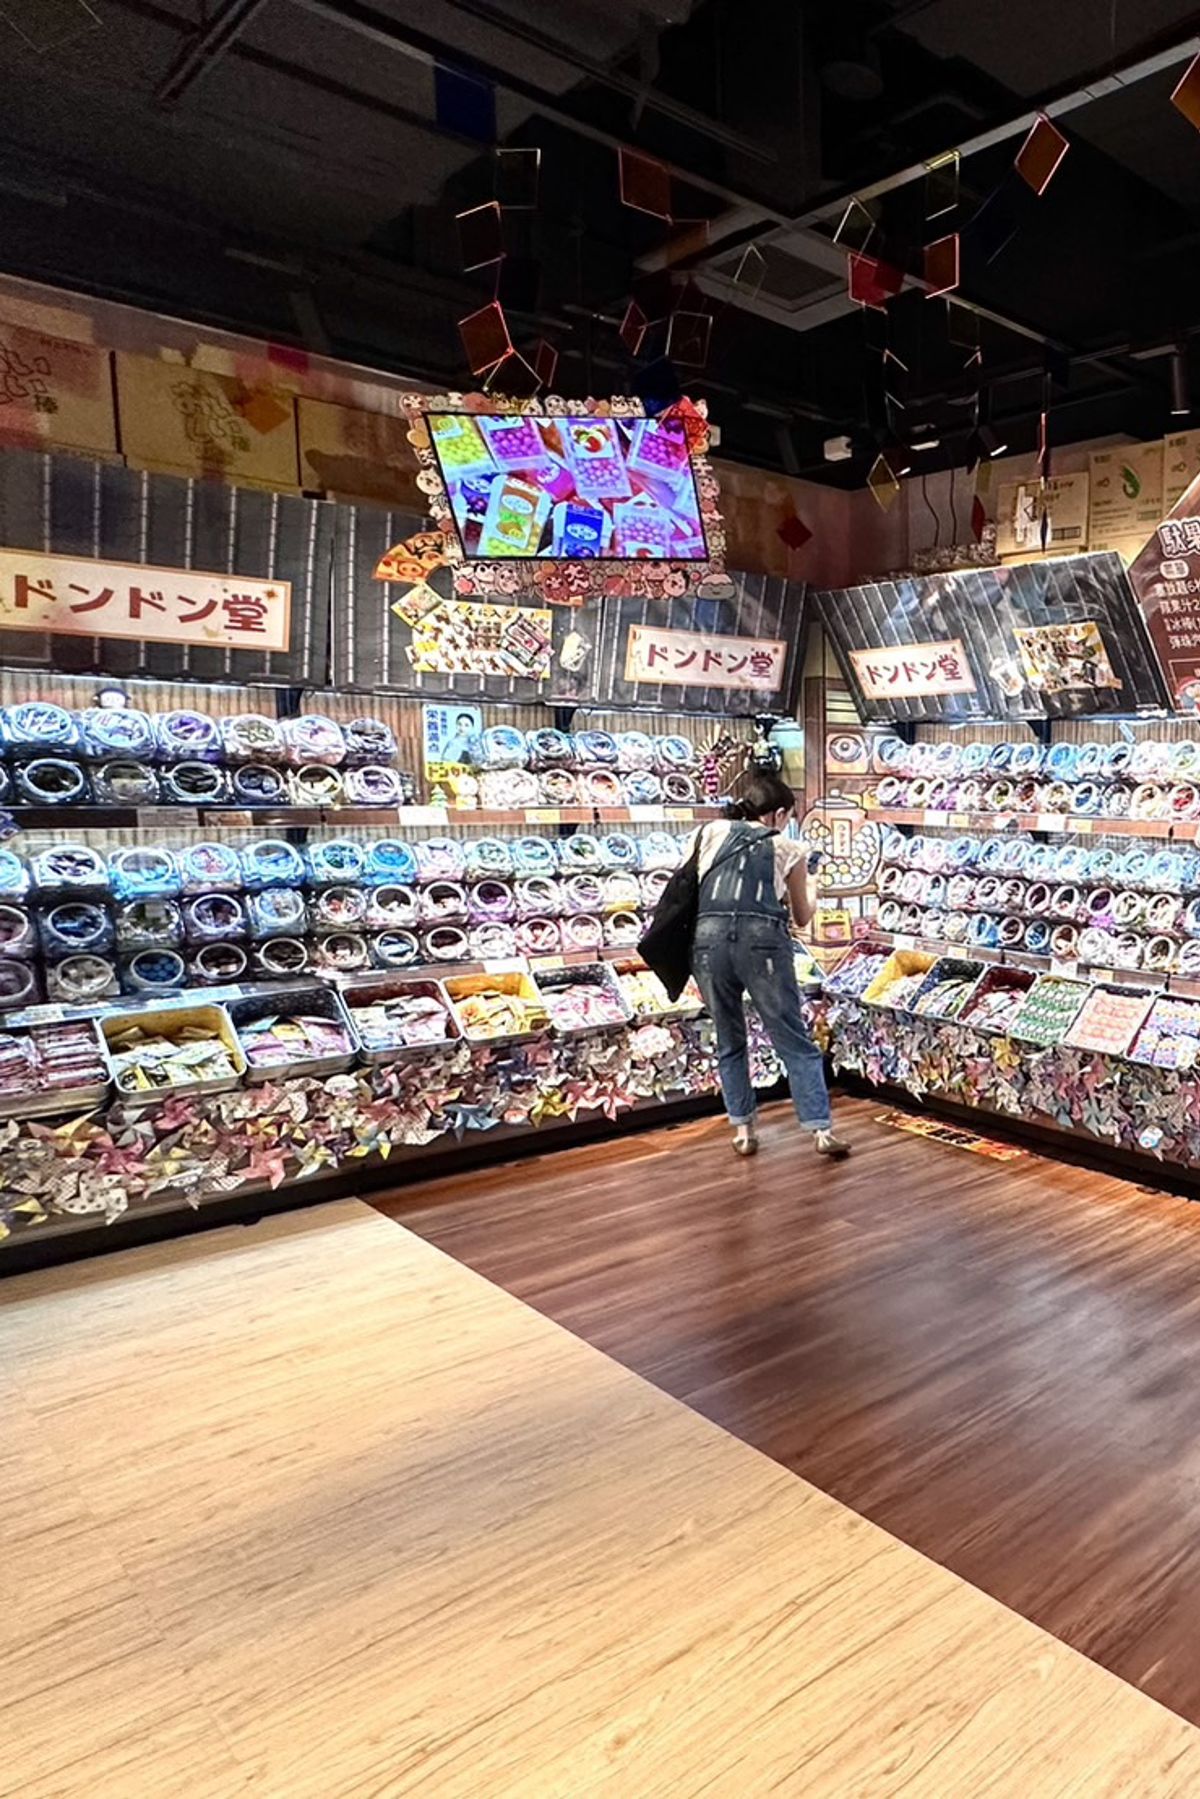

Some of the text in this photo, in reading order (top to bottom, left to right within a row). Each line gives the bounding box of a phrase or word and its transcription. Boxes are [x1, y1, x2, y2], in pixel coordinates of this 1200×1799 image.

[14, 573, 268, 632] ドンドン堂
[647, 643, 774, 679] ドンドン堂
[865, 653, 963, 685] ドンドン堂
